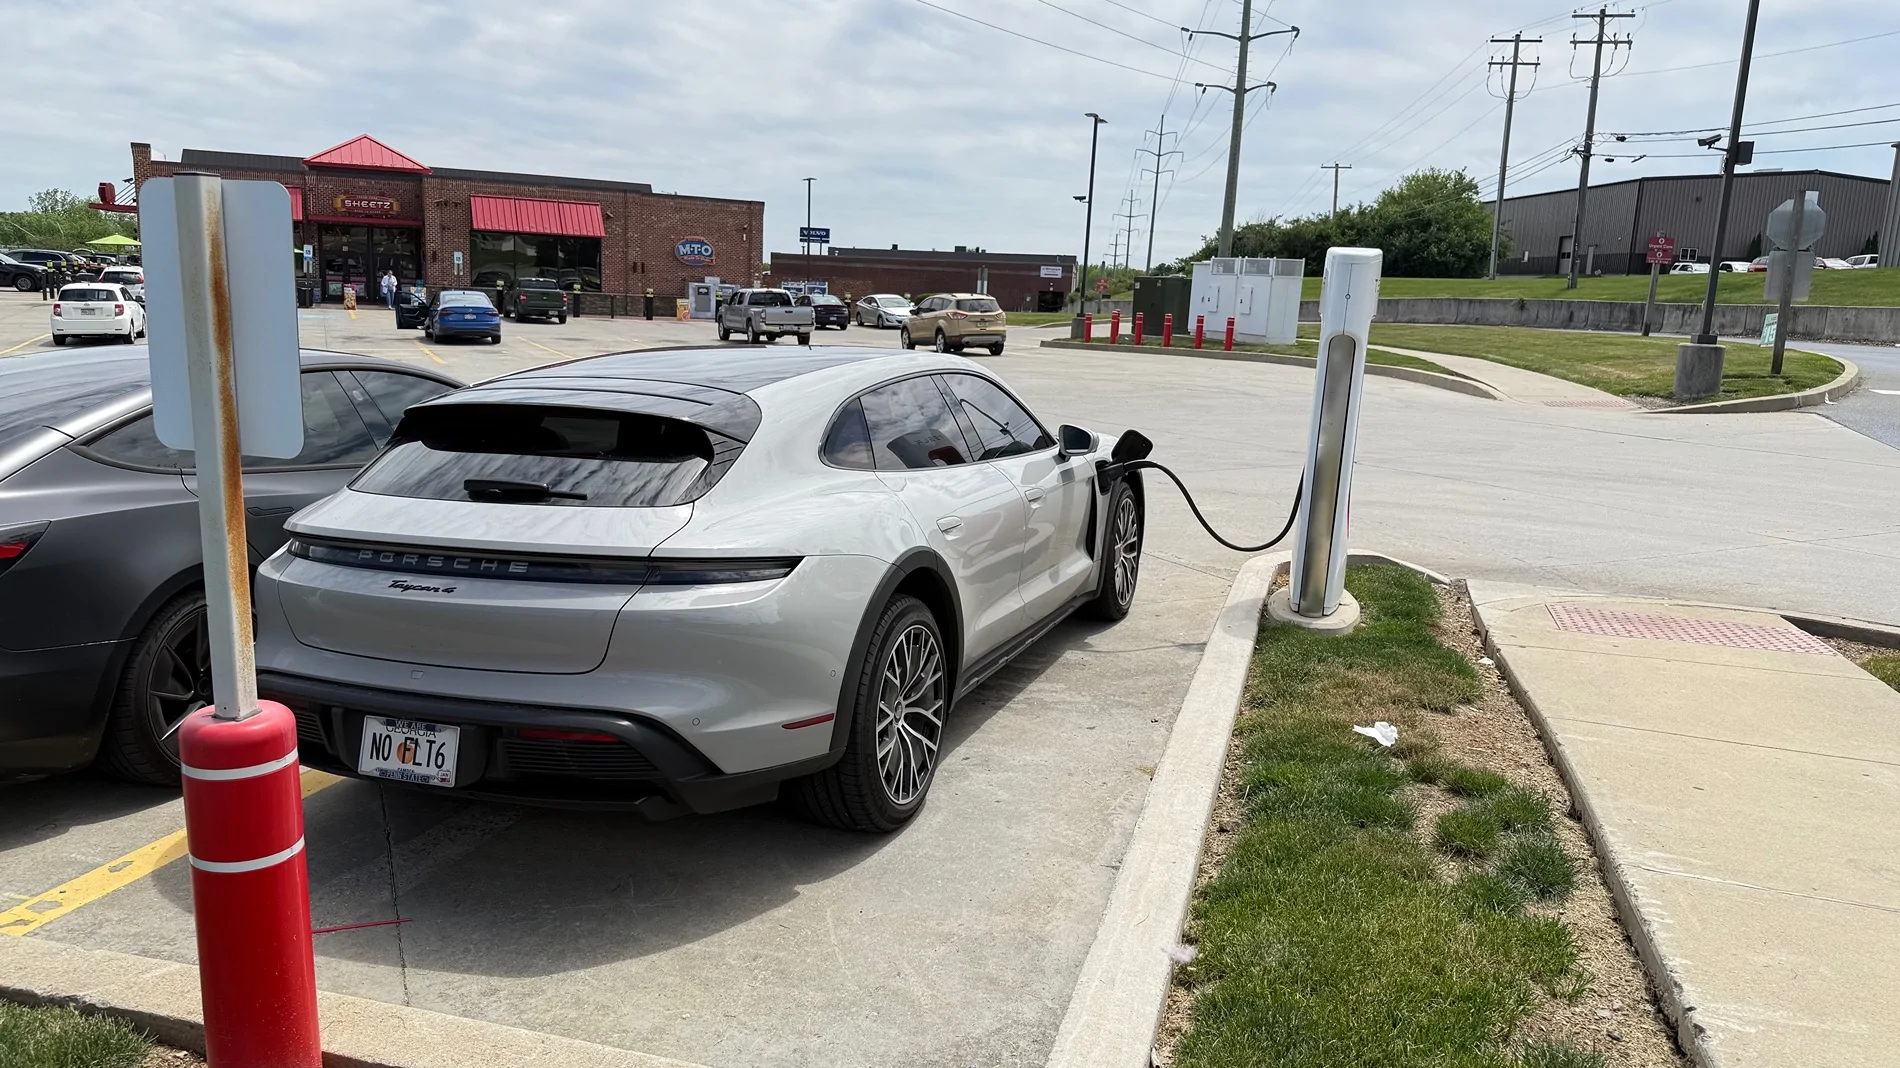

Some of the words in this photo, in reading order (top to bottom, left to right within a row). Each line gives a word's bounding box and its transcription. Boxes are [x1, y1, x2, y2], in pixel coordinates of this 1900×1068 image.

[345, 200, 390, 209] SHEETZ
[359, 550, 529, 573] PORSCHE
[389, 580, 441, 593] Taycan
[395, 720, 409, 728] WE
[411, 722, 426, 730] ARE
[370, 732, 392, 761] NO
[402, 737, 446, 769] FLT6
[403, 772, 422, 782] STATE
